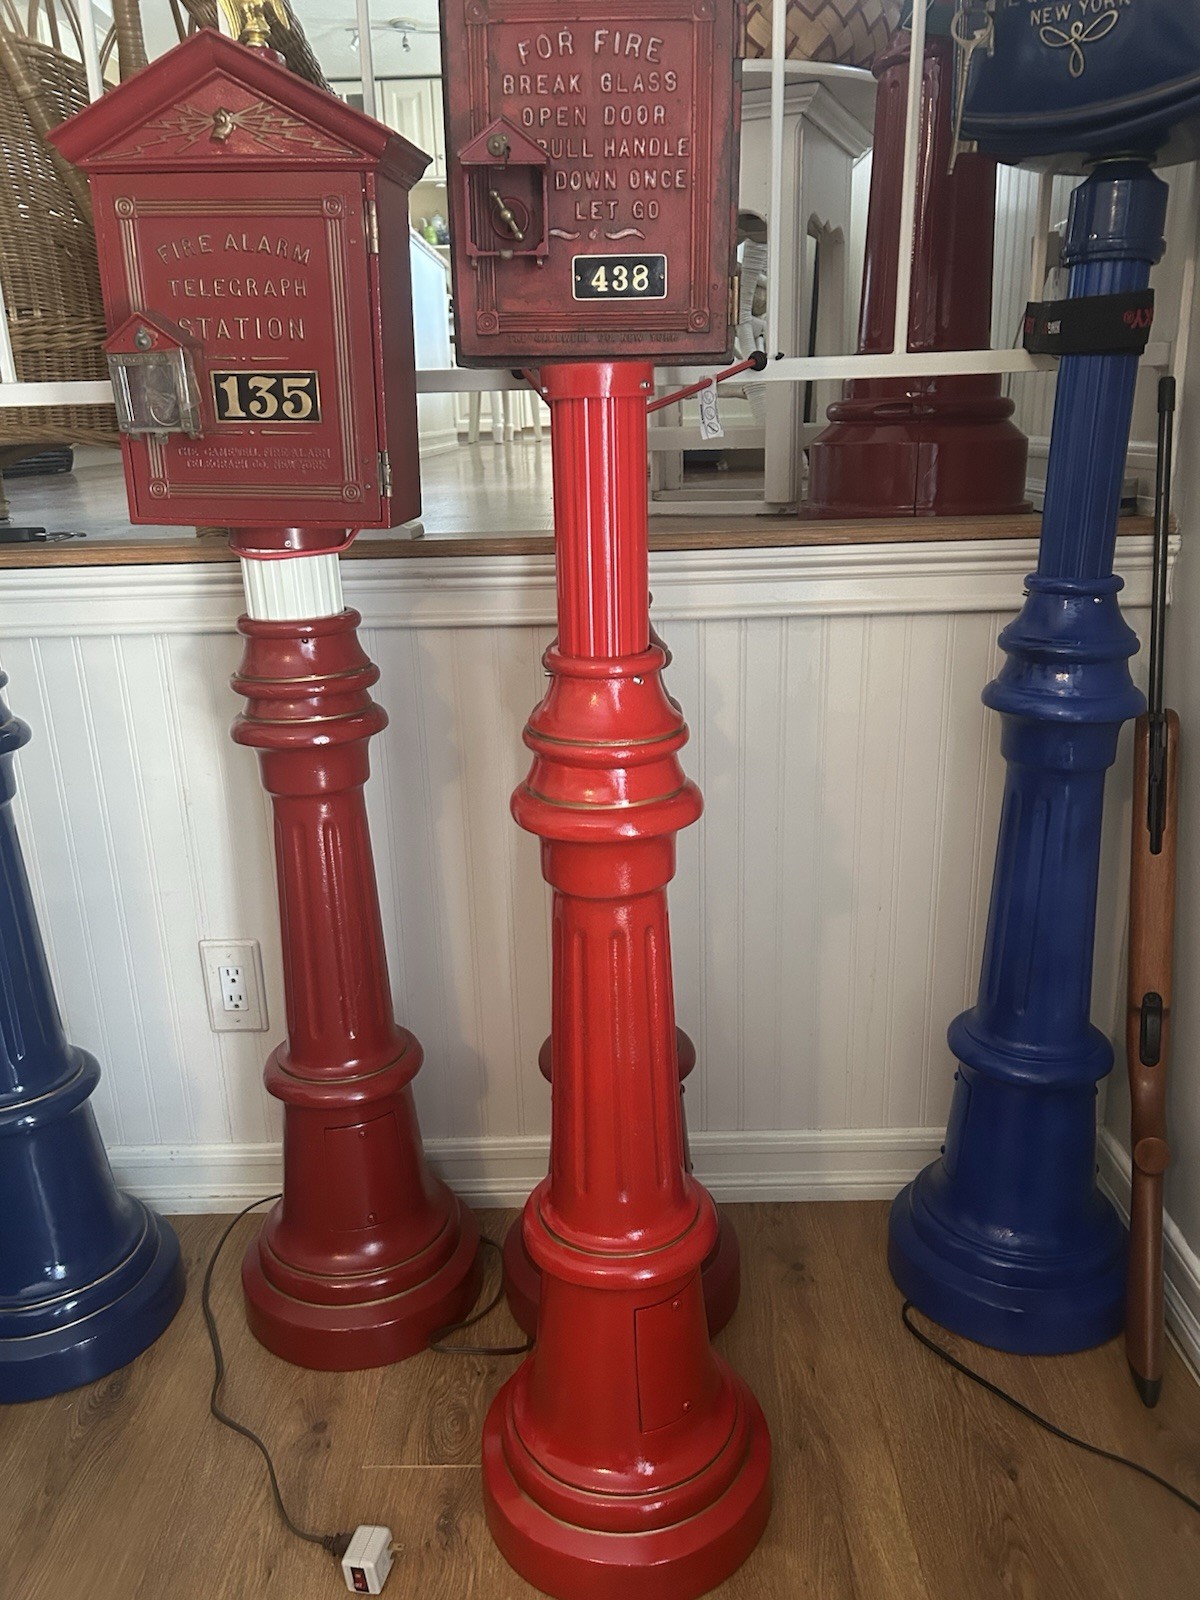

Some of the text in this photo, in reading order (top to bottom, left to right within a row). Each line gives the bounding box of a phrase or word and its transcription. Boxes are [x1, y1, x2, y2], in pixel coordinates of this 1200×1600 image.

[1030, 4, 1072, 26] NEW
[518, 28, 665, 65] FOR FIRE
[502, 71, 678, 95] BREAK GLASS
[522, 105, 666, 127] OPEN DOOR
[604, 137, 690, 159] HANDLE
[555, 169, 688, 191] DOWN ONCE
[575, 200, 661, 221] LET GO
[156, 234, 312, 267] FIRE ALARM
[168, 278, 308, 298] TELEGRAPH
[591, 265, 650, 292] 438
[177, 317, 306, 341] STATION
[219, 375, 314, 419] 135
